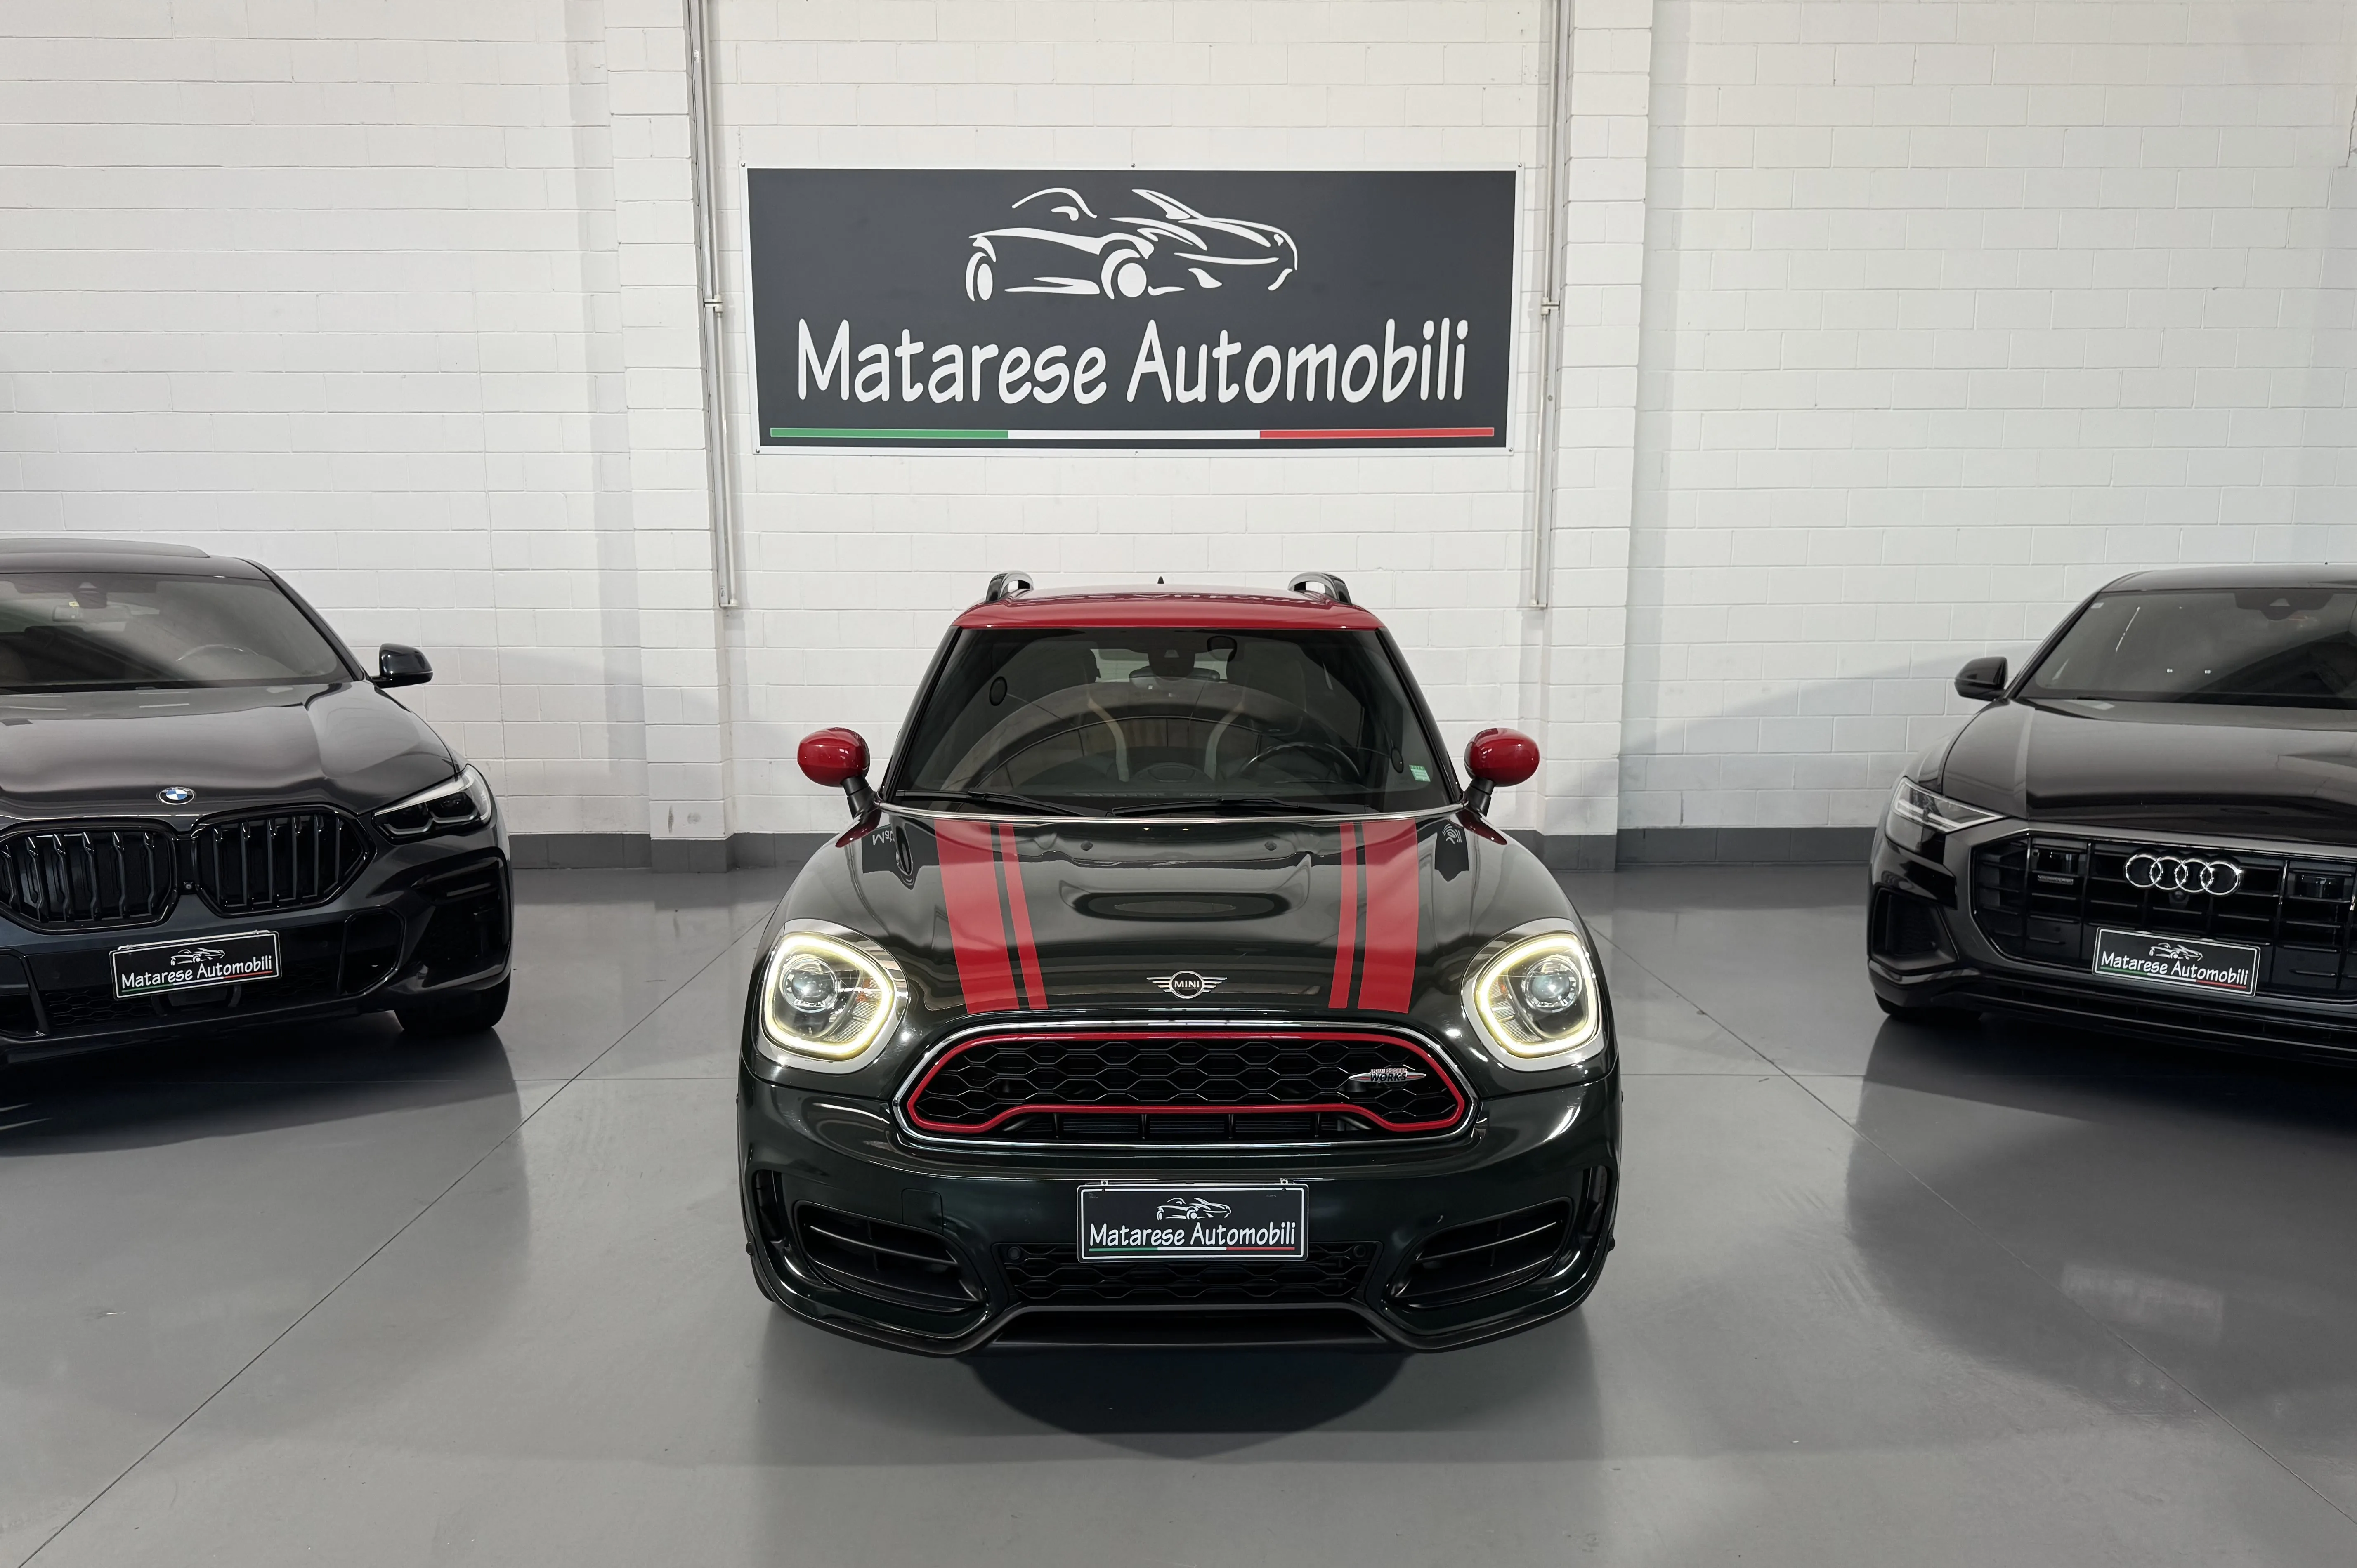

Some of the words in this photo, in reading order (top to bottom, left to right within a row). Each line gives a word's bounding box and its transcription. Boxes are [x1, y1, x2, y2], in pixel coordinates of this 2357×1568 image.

[798, 318, 1107, 404] Matarese
[1127, 318, 1468, 404] Automobili
[121, 969, 193, 989] Matarese
[197, 955, 272, 979] Automobili
[2101, 950, 2168, 975] Matarese
[2170, 960, 2249, 985] Automobili
[1370, 1073, 1406, 1082] WORKS
[1090, 1223, 1185, 1246] Matarese
[1190, 1221, 1296, 1245] Automobili
